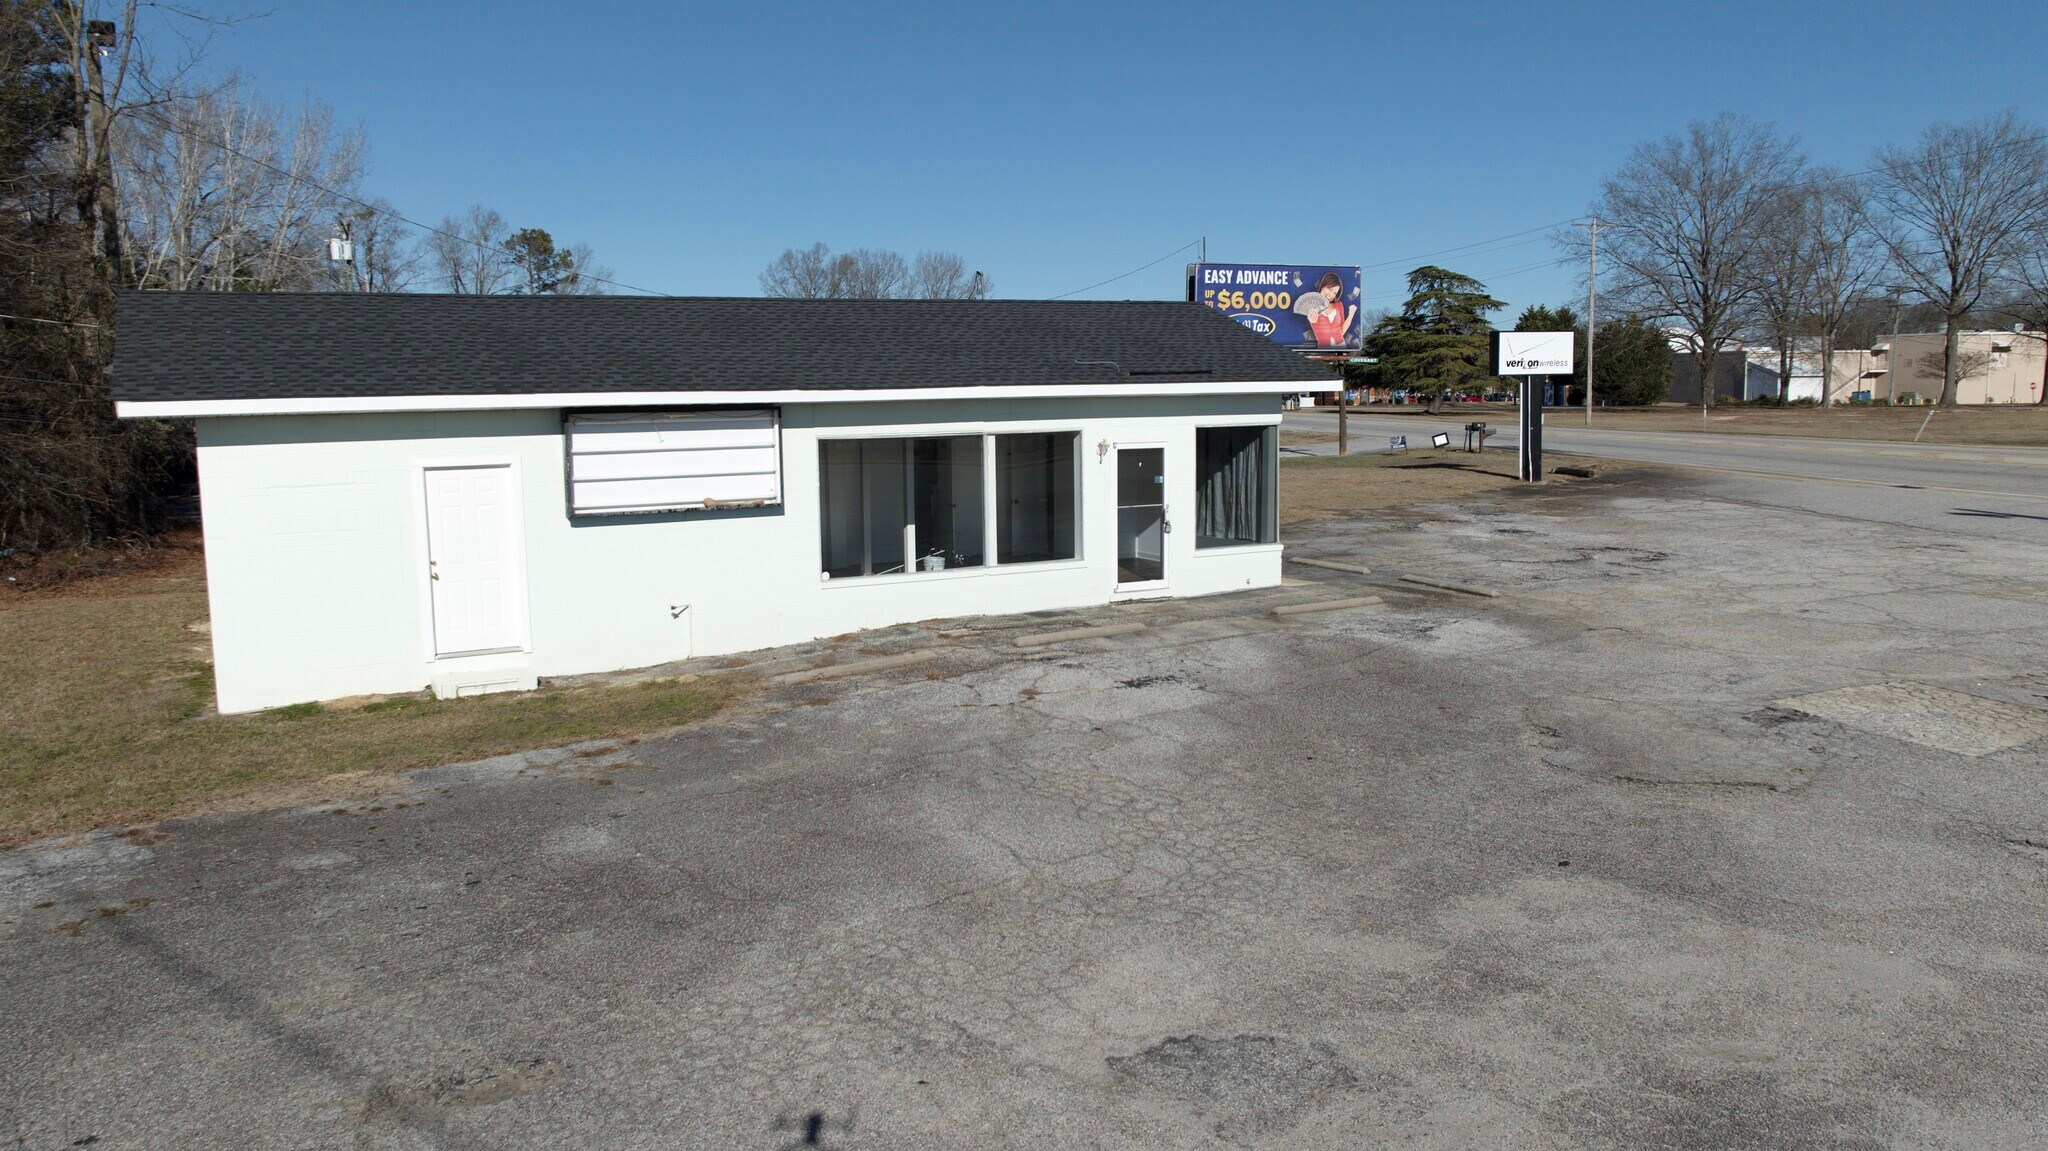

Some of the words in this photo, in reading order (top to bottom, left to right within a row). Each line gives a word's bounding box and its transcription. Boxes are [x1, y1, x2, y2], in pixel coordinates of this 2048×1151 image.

[1204, 270, 1233, 284] EASY
[1236, 270, 1288, 285] ADVANCE
[1204, 290, 1215, 298] UP
[1217, 288, 1291, 311] $6,000
[1252, 319, 1270, 332] Tax
